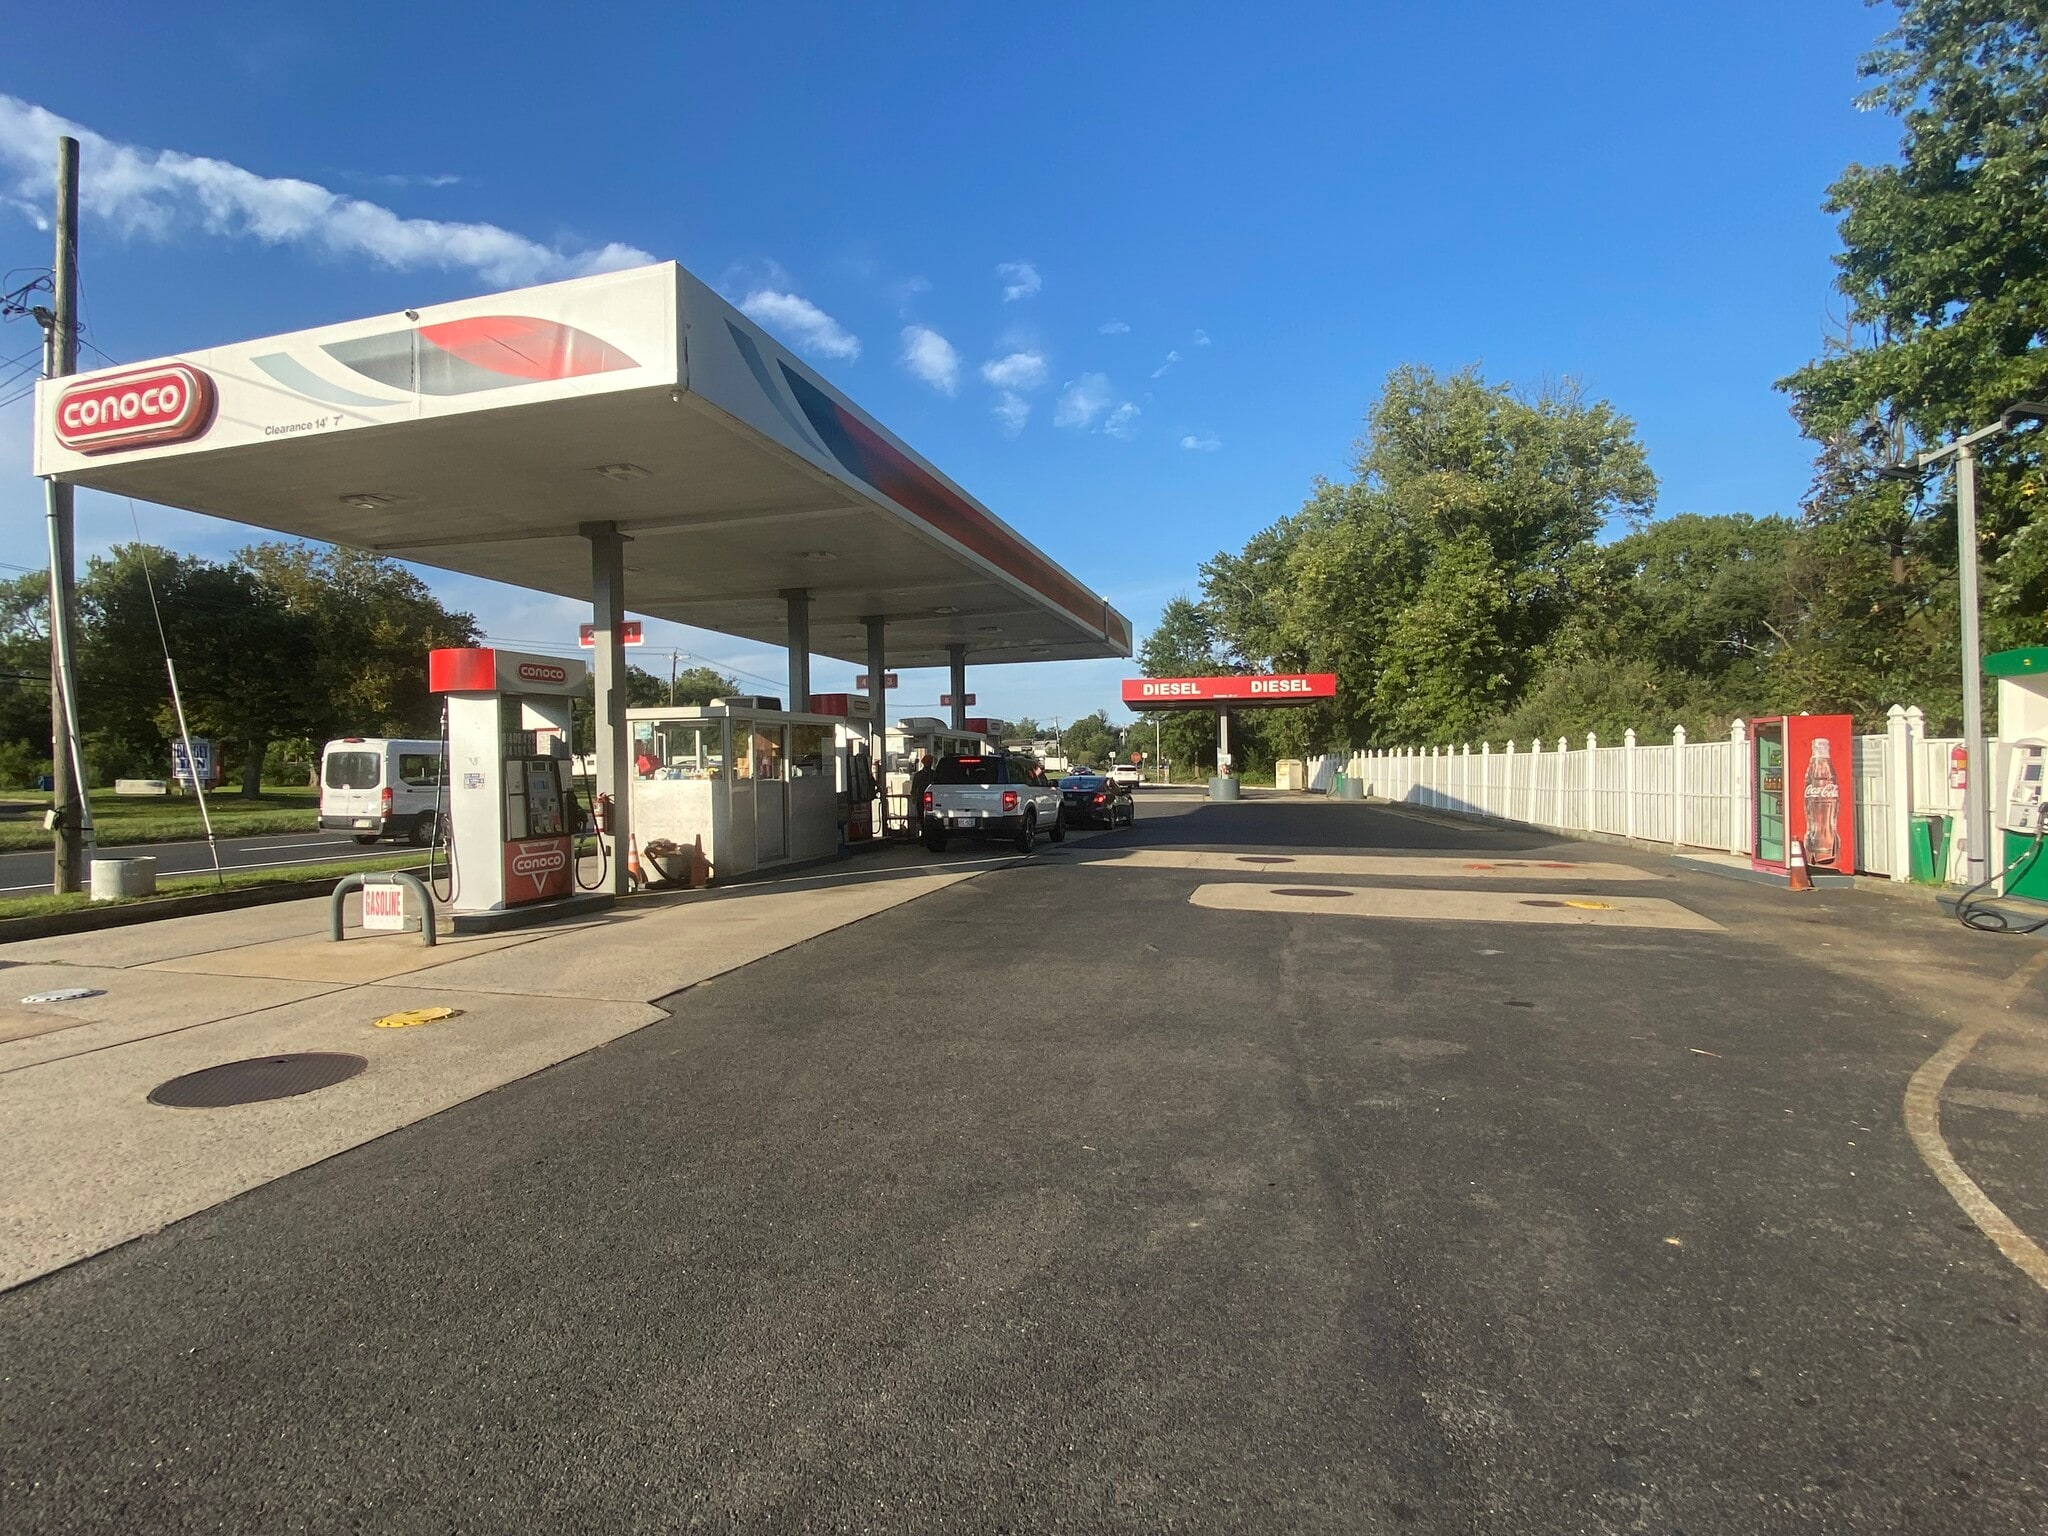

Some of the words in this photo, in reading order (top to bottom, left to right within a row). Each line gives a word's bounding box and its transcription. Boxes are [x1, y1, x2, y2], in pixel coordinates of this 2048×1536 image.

[265, 421, 313, 436] Clearance
[1142, 682, 1202, 696] DIESEL
[1250, 679, 1312, 694] DIESEL
[176, 744, 208, 759] BUGET
[365, 890, 401, 917] GASOLINE
